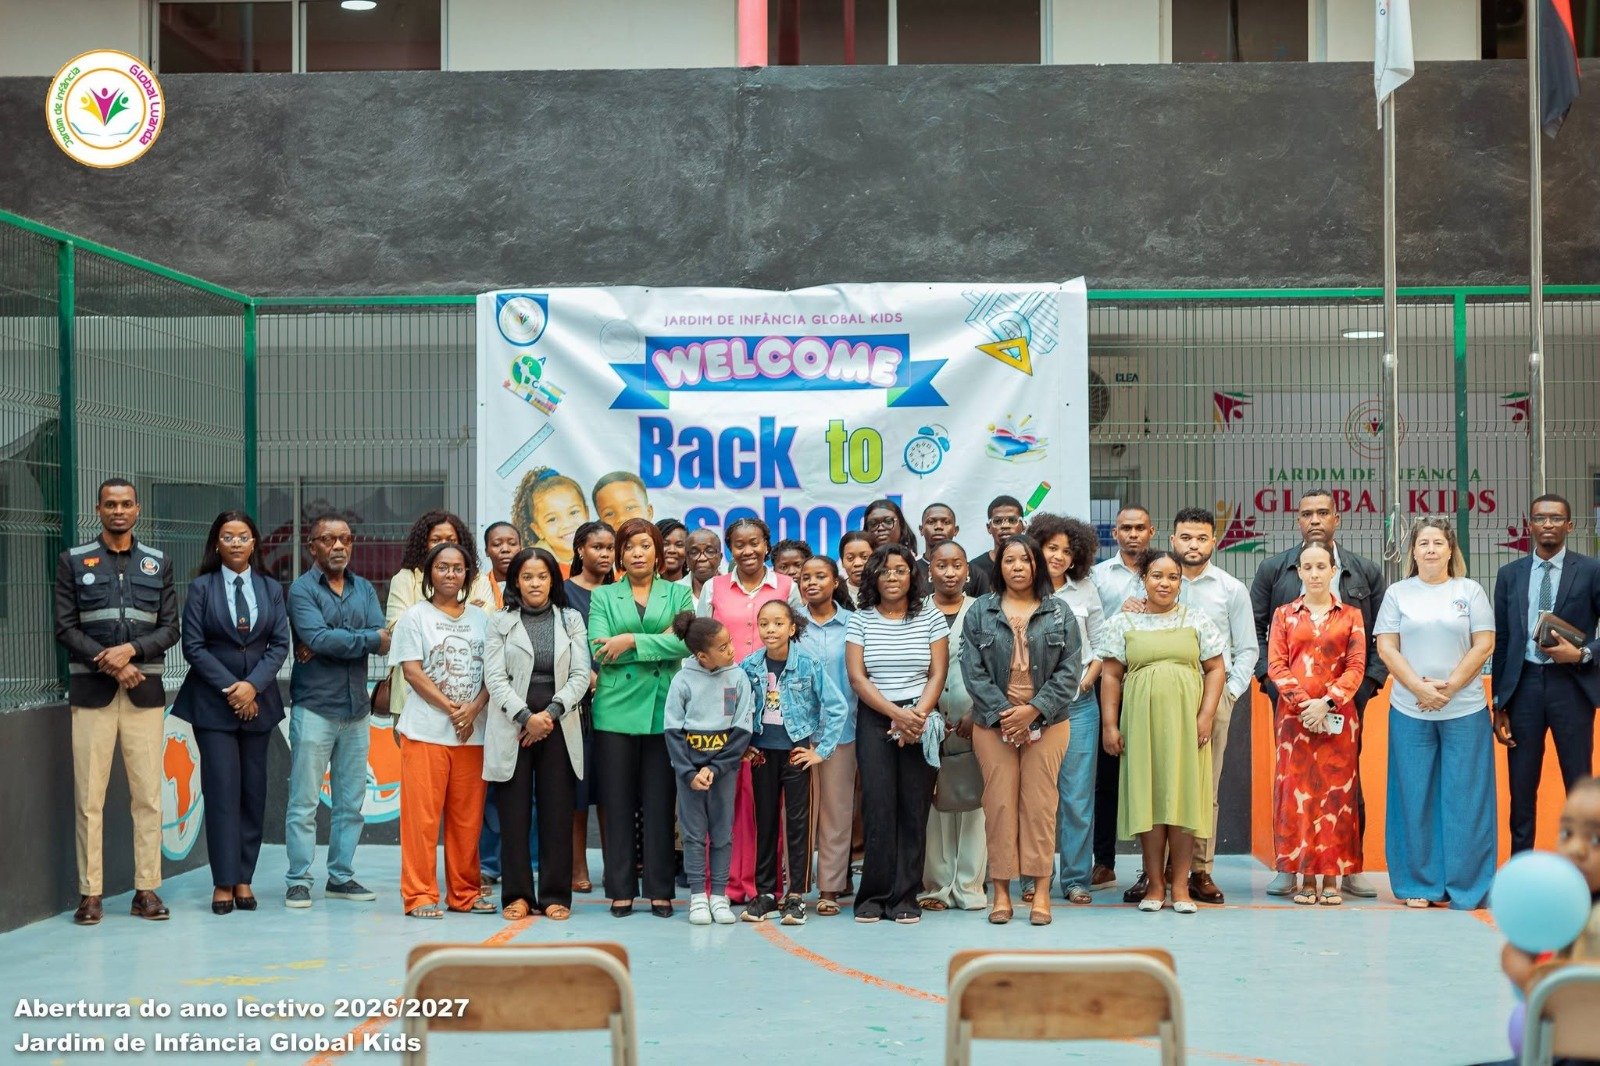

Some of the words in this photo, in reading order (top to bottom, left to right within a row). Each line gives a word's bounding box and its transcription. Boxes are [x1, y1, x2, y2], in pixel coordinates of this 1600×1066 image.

[664, 315, 712, 326] JARDIM
[718, 315, 735, 325] DE
[740, 312, 806, 325] INFÂNCIA
[812, 314, 865, 325] GLOBAL
[871, 312, 903, 324] KIDS
[652, 336, 902, 389] WELCOME
[638, 416, 802, 490] Back
[825, 419, 883, 484] to
[1268, 468, 1345, 484] JARDIM
[1352, 468, 1376, 481] DE
[1255, 489, 1385, 513] GLBA
